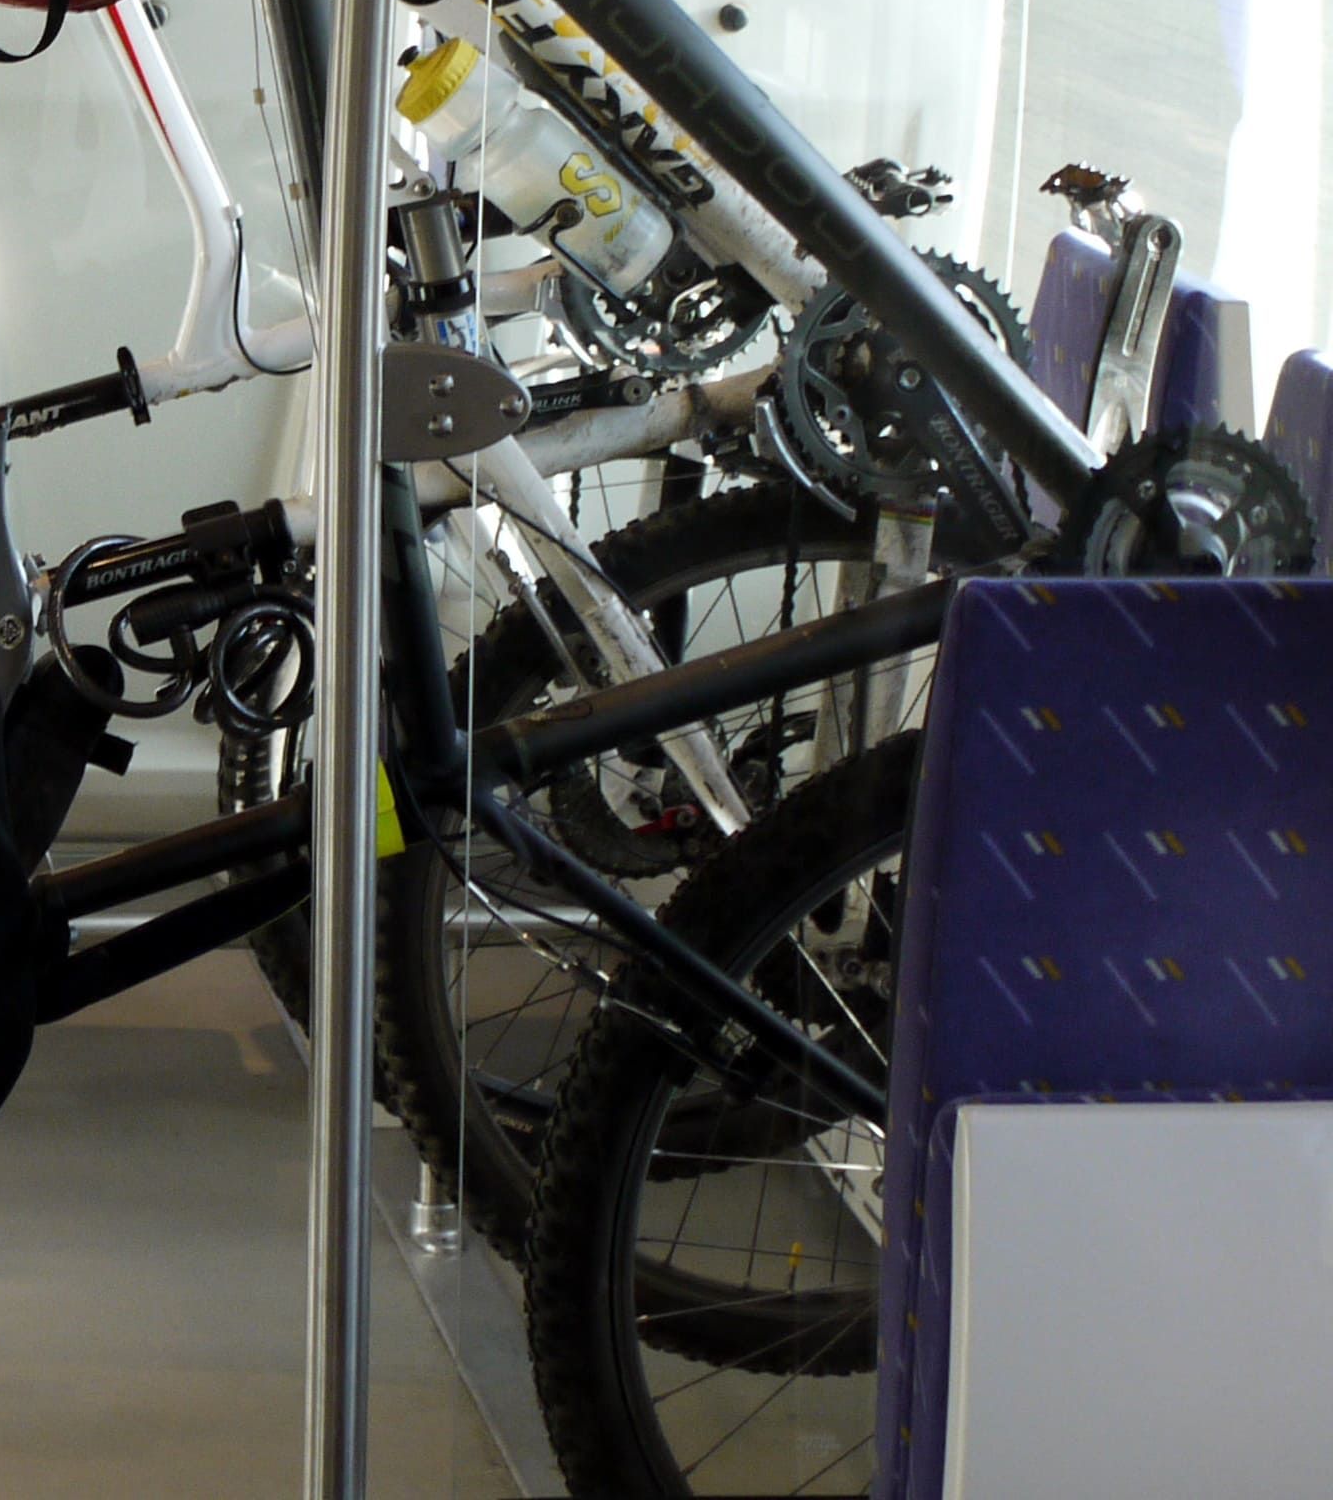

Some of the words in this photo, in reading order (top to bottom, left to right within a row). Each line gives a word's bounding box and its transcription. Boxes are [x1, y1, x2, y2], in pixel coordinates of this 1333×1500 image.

[552, 57, 721, 213] GARY
[10, 405, 65, 431] ANT
[85, 550, 195, 591] BONTRAGE
